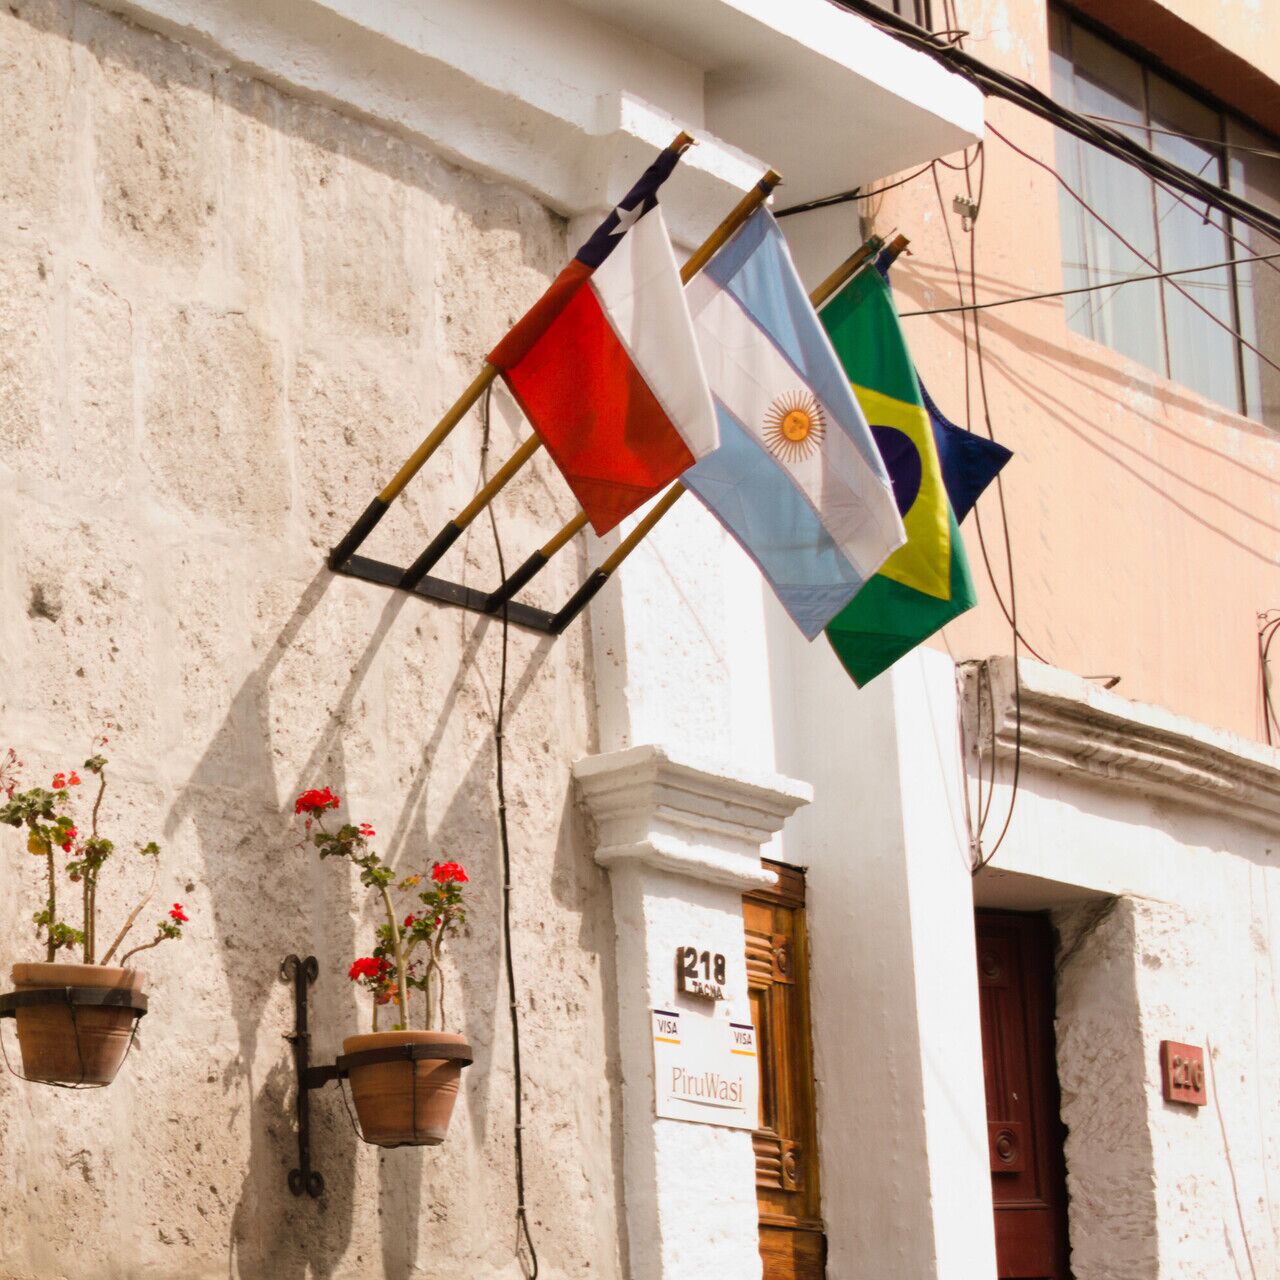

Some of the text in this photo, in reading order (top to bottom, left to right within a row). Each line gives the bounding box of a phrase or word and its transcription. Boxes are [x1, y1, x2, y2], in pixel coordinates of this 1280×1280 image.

[683, 946, 726, 985] 218
[692, 980, 725, 1000] TACNA
[657, 1019, 679, 1035] VISA
[733, 1031, 753, 1046] VISA
[672, 1066, 743, 1102] PiruWasi
